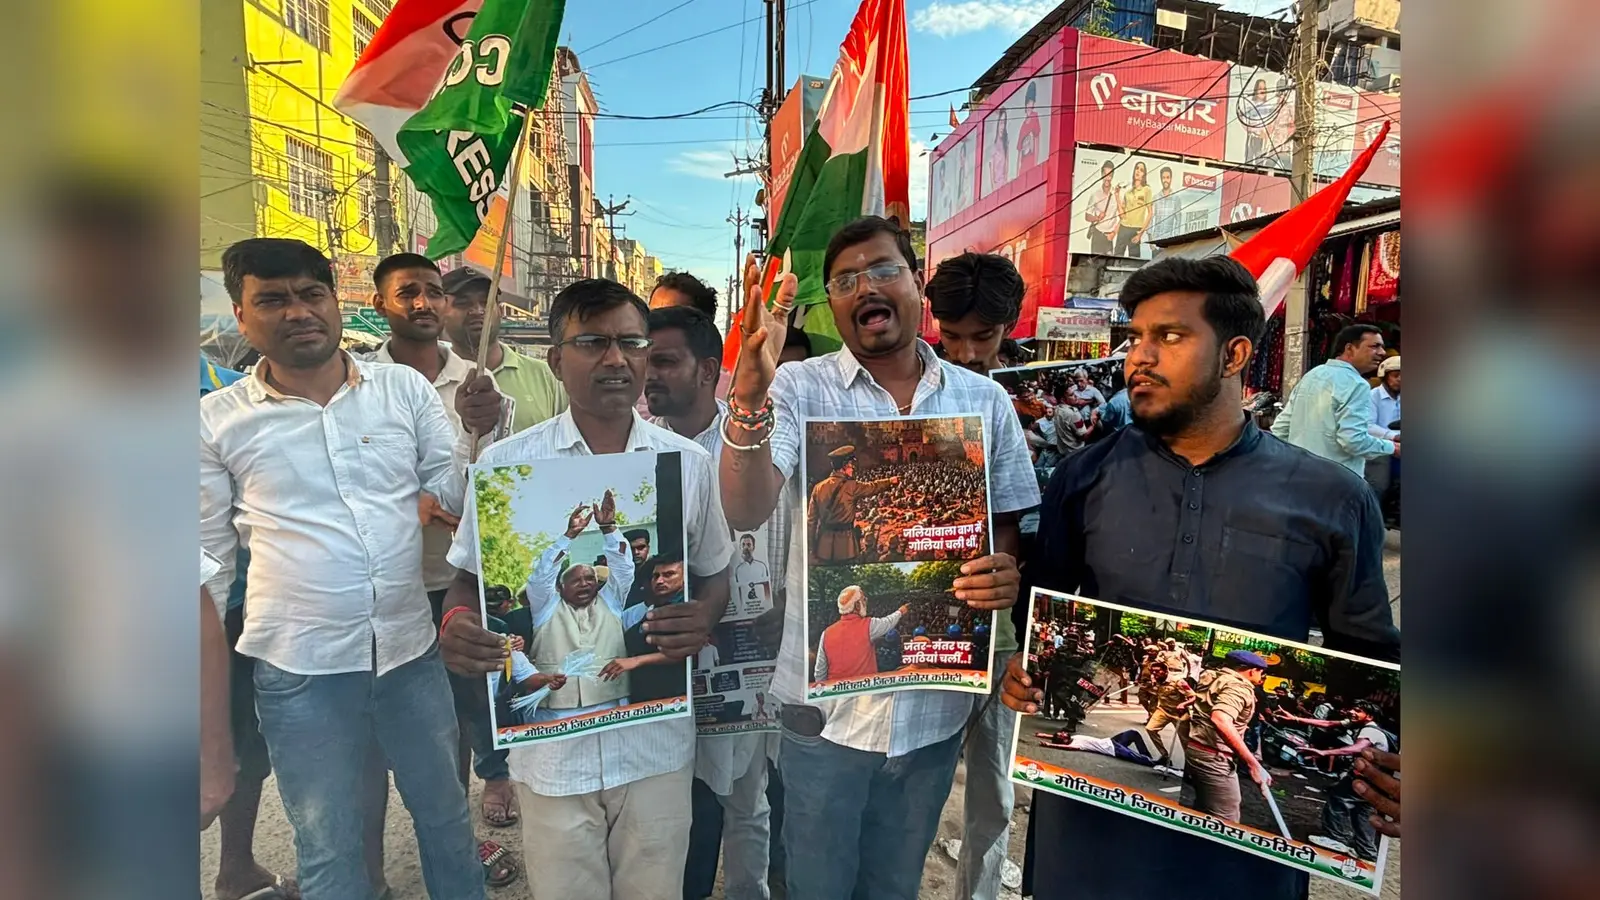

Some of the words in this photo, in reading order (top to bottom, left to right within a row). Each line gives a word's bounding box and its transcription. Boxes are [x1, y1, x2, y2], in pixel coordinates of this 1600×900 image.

[1120, 86, 1218, 124] बाजार
[1127, 117, 1210, 138] #MyBaazarMbaazar
[903, 524, 956, 538] जलियांवाला
[974, 520, 982, 533] में
[908, 537, 944, 551] गोलियां
[944, 536, 965, 549] चली
[903, 638, 956, 651] जंतर-मंतर
[956, 641, 972, 651] पर
[902, 651, 938, 664] लाठियां
[831, 678, 871, 692] मोतिहारी
[873, 675, 896, 686] जिला
[898, 670, 929, 682] कांग्रेस
[931, 671, 962, 682] कमिटी
[524, 722, 568, 738] मोतिहारी
[570, 716, 597, 730] जिला
[598, 710, 631, 724] कांग्रेस
[632, 703, 664, 717] कमिटी
[1055, 774, 1127, 804] मोतिहारी
[1130, 793, 1178, 819] जिला
[1181, 812, 1246, 841] कांग्रेस
[1250, 833, 1318, 864] कमिटी
